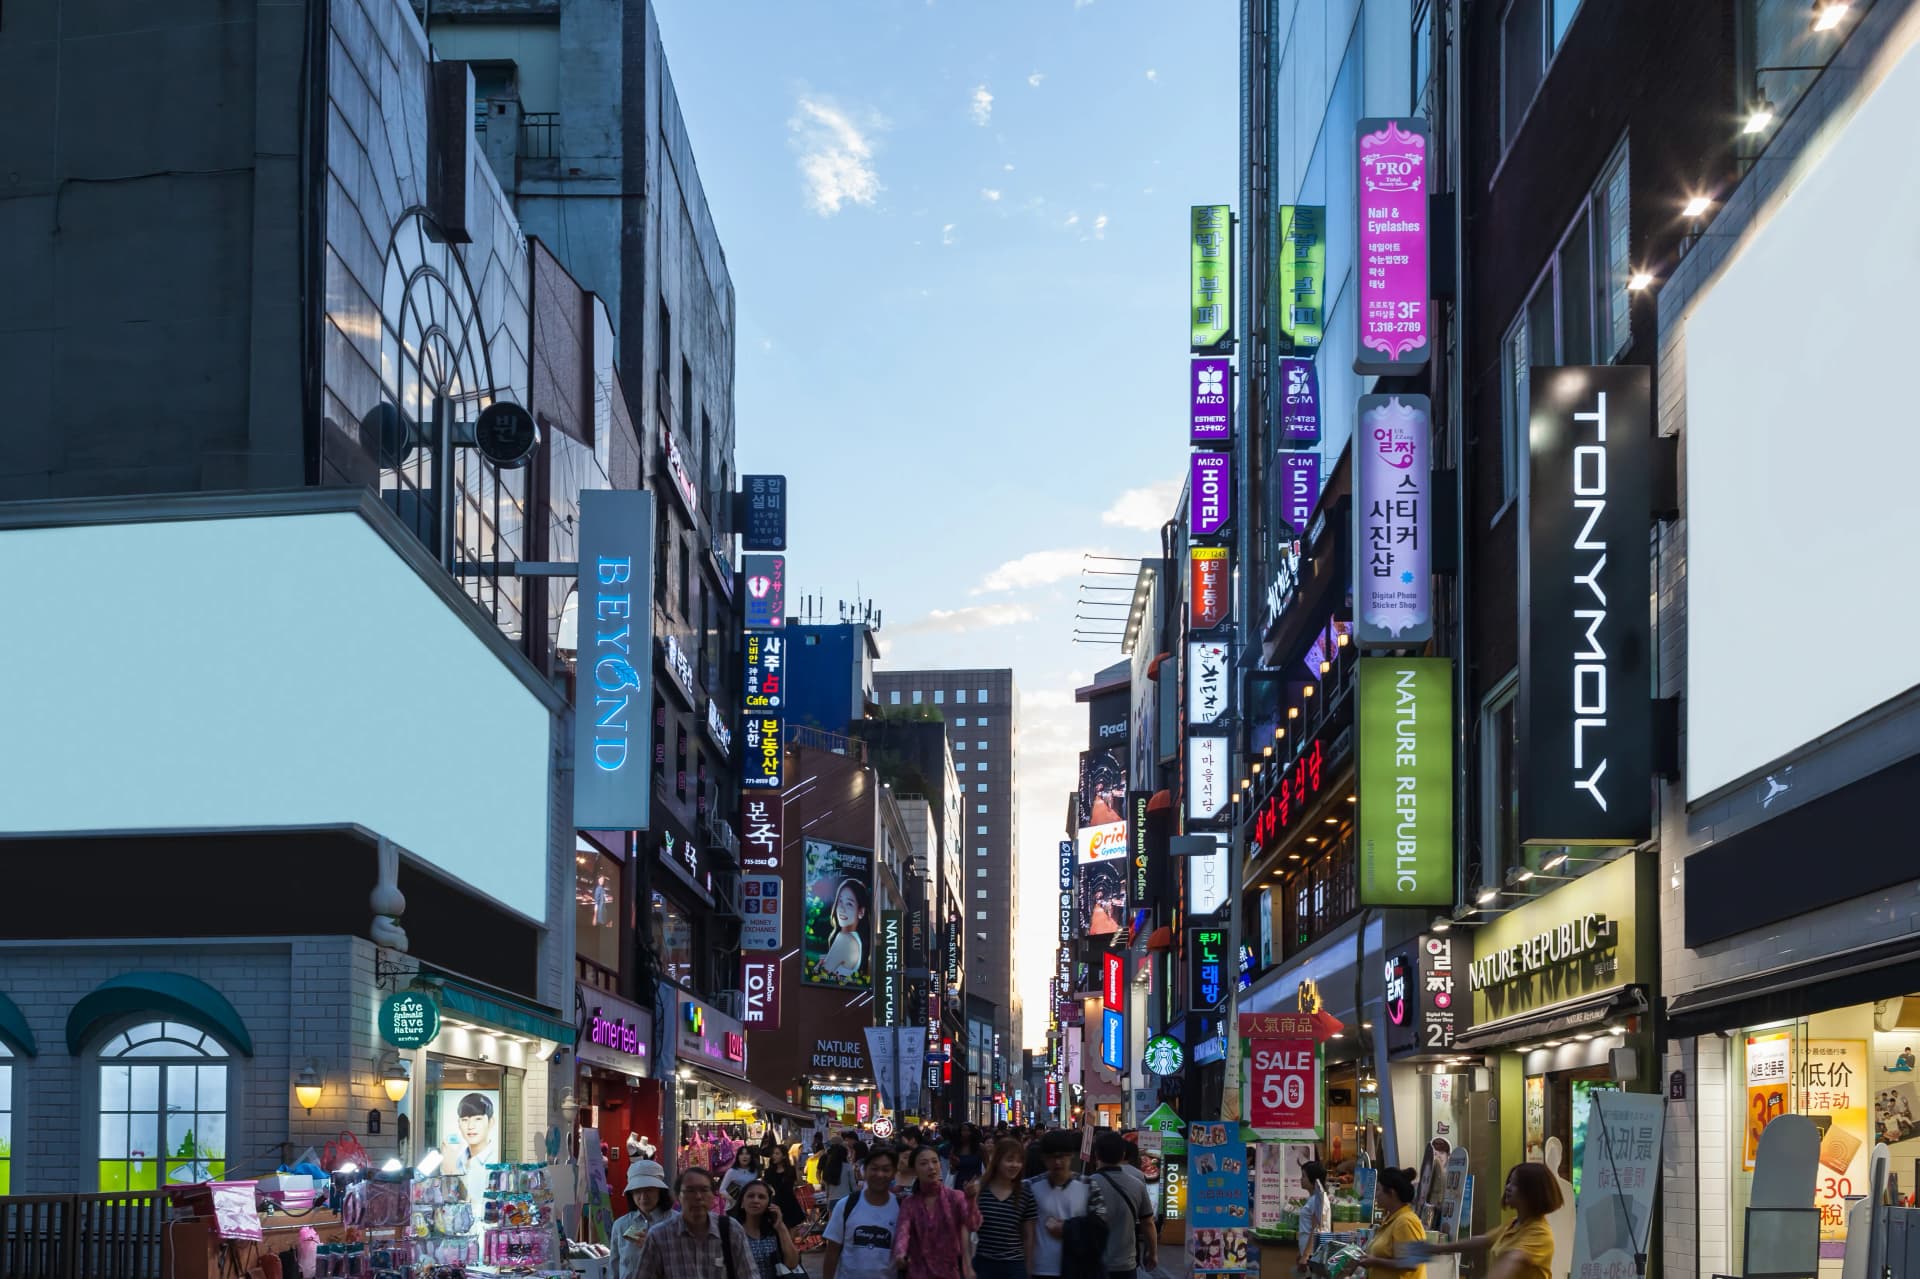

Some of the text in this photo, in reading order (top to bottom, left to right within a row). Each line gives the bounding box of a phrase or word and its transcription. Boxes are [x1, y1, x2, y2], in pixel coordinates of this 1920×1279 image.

[1375, 162, 1411, 175] PRO
[1368, 208, 1399, 218] Nail &
[1368, 221, 1420, 234] Eyelashes
[1368, 243, 1400, 252] 네일아트
[1196, 208, 1223, 330] 초밥 부페
[1369, 280, 1385, 289] 태닝
[1398, 302, 1420, 318] 3F
[1368, 322, 1421, 332] T.318-2789
[1196, 396, 1224, 404] MIZO
[1194, 415, 1226, 423] ESTHETIC
[1374, 428, 1416, 469] 얼짱
[752, 494, 781, 509] 설비
[1202, 469, 1219, 528] HOTEL
[1396, 474, 1419, 550] 스티커
[1218, 529, 1232, 538] 4F
[1369, 499, 1394, 577] 사진샵
[1200, 560, 1220, 572] 성모
[772, 559, 784, 613] マッサージ
[1202, 573, 1218, 622] 부동산
[1372, 592, 1396, 600] Digital
[1574, 392, 1607, 812] TONYMOLY
[1399, 602, 1417, 610] Shop
[1219, 624, 1231, 633] 3F
[592, 556, 634, 771] BEYOND
[746, 695, 768, 706] Cafe
[1100, 719, 1127, 737] Reel
[1218, 719, 1231, 727] 3F
[747, 719, 760, 748] 신한
[761, 719, 779, 776] 부동산
[1202, 740, 1215, 811] 새마을식당
[1396, 670, 1416, 892] NATURE REPUBLIC
[1218, 814, 1231, 822] 2F
[745, 802, 780, 853] 본죽
[1137, 798, 1146, 900] Gloria Jean's Coffees
[1200, 933, 1221, 944] 루키
[1469, 913, 1597, 992] NATURE REPUBLIC
[1202, 947, 1219, 1004] 노래방
[1426, 938, 1455, 1009] 얼짱
[745, 964, 764, 1021] LOVE
[393, 1003, 423, 1011] Save
[393, 1019, 424, 1027] Save
[1247, 1017, 1313, 1033] 人氣商品
[1427, 1024, 1454, 1046] 2F
[817, 1039, 861, 1054] NATURE
[812, 1054, 865, 1069] REPUBLIC
[1255, 1050, 1311, 1070] SALE
[1792, 1062, 1853, 1087] 低价
[1262, 1074, 1304, 1109] 50
[1768, 1094, 1781, 1106] SALE
[1793, 1092, 1850, 1111] 量活动
[1159, 1120, 1173, 1131] 8F
[1166, 1163, 1178, 1217] ROOKIE
